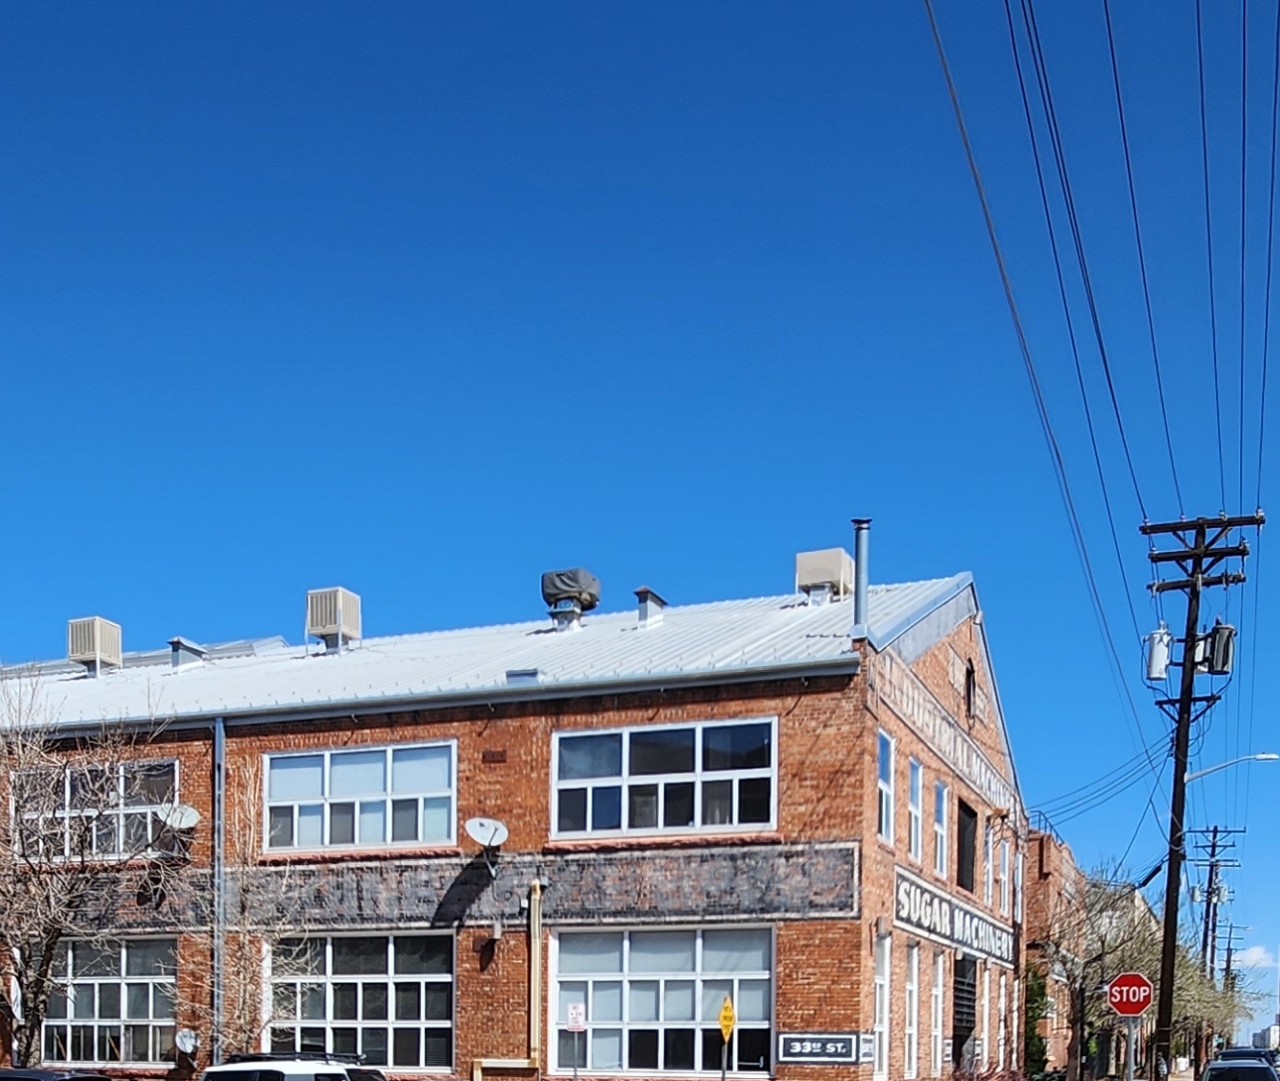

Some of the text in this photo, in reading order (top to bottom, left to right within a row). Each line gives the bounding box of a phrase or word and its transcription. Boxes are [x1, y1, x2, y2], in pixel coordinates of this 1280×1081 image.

[898, 881, 950, 937] SUGAR
[954, 908, 1013, 961] MACHINERY
[1110, 986, 1150, 1003] STOP
[825, 1041, 847, 1054] ST.
